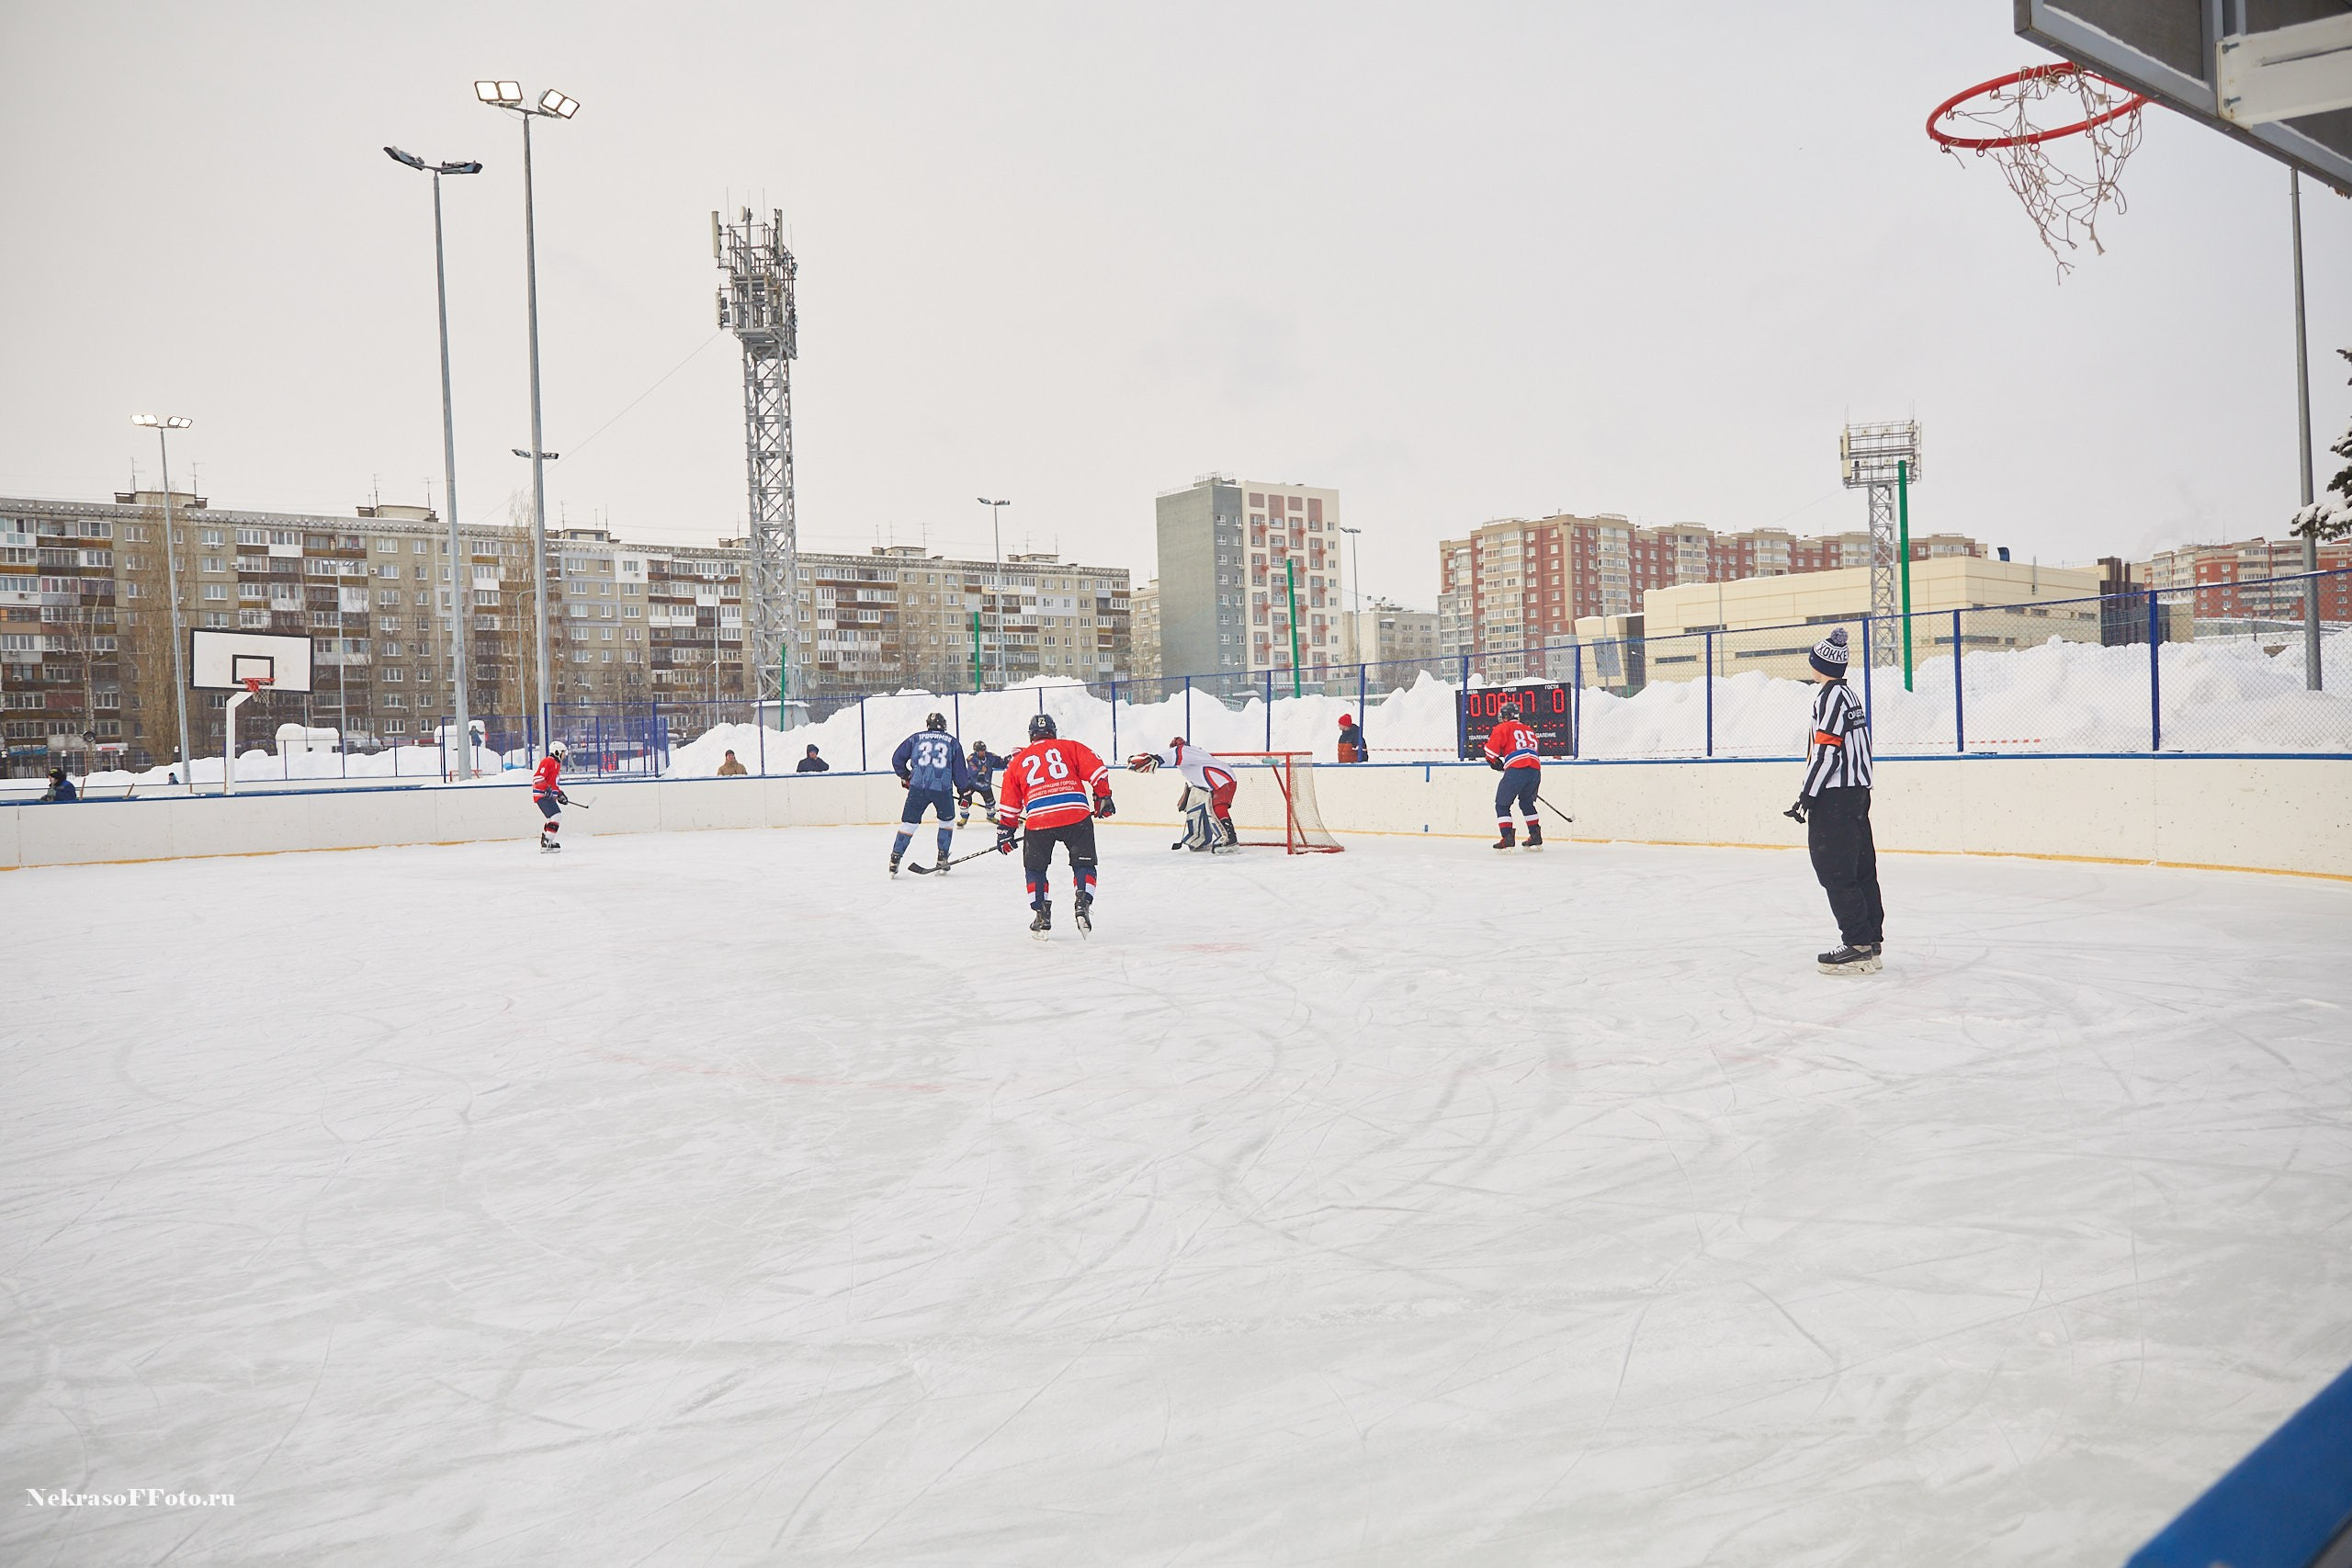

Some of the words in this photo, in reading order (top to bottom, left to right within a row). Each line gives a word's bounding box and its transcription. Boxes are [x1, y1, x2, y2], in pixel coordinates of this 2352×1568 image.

[1470, 694, 1482, 717] 0
[1552, 688, 1565, 714] 0
[919, 733, 953, 743] ТРОФИМОВ
[1513, 729, 1538, 750] 85
[918, 741, 948, 769] 33
[1022, 748, 1069, 787] 28
